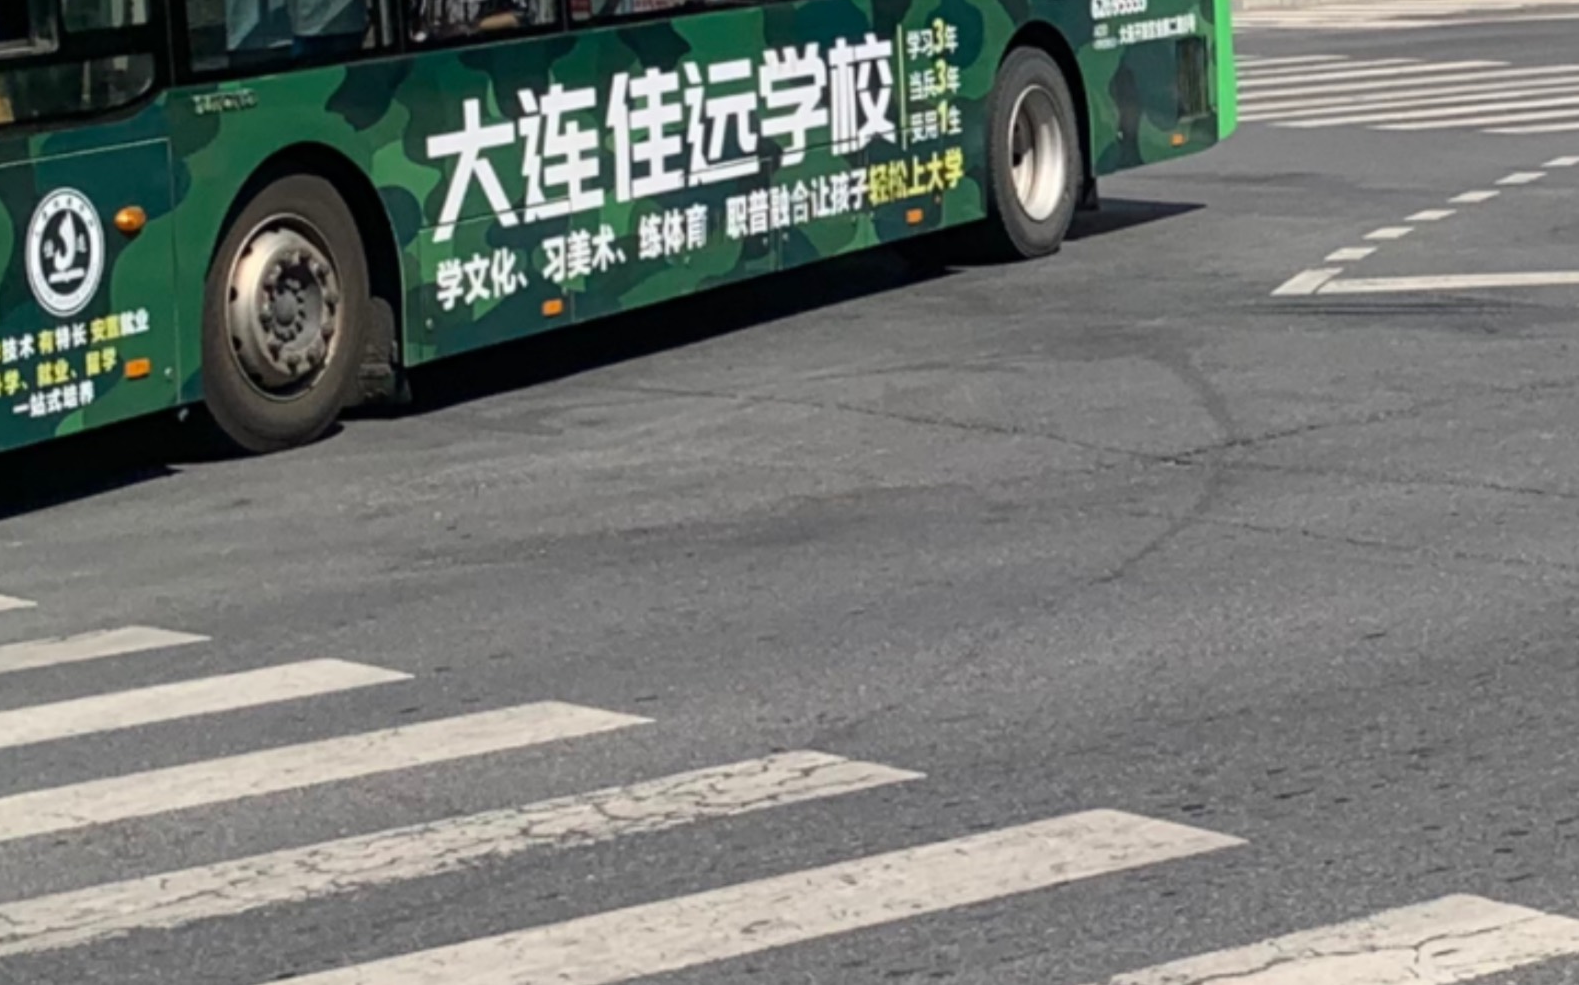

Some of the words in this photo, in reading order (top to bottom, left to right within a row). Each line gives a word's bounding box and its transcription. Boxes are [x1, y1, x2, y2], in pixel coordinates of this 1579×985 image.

[906, 17, 959, 61] 学习3年
[426, 33, 897, 243] 大连佳远学校
[436, 249, 528, 311] 学文化、
[542, 226, 627, 283] 习美术、
[638, 204, 708, 260] 练体育
